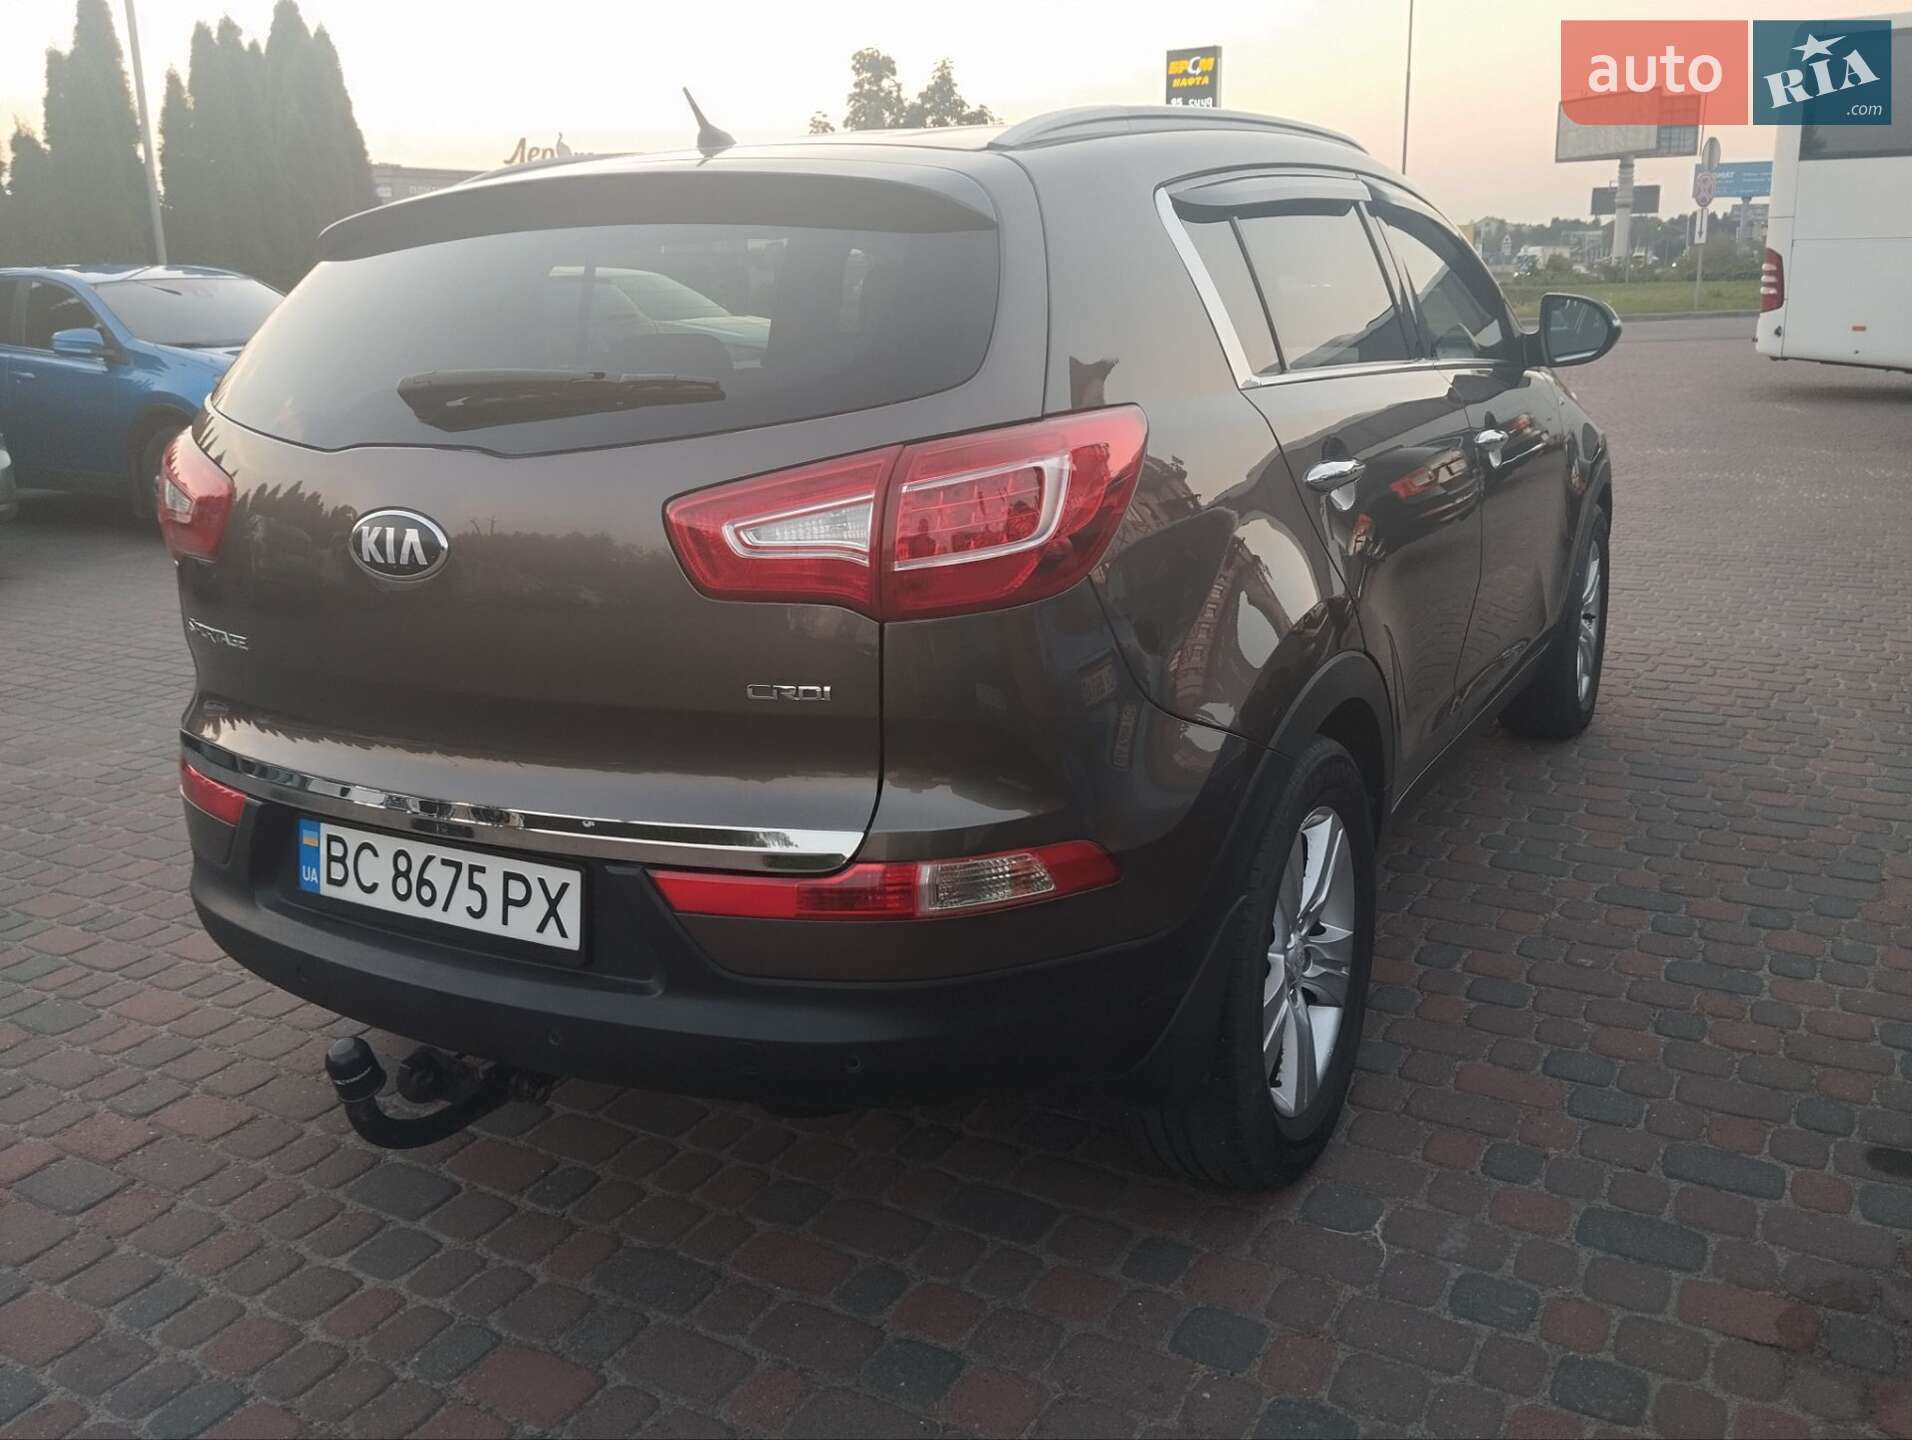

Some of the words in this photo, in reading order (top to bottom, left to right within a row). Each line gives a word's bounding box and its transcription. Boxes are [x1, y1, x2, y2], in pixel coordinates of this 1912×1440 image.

[361, 526, 428, 566] KIA
[302, 866, 319, 883] UA
[326, 833, 379, 894] BC
[391, 849, 488, 919] 8675
[502, 870, 570, 938] PX
